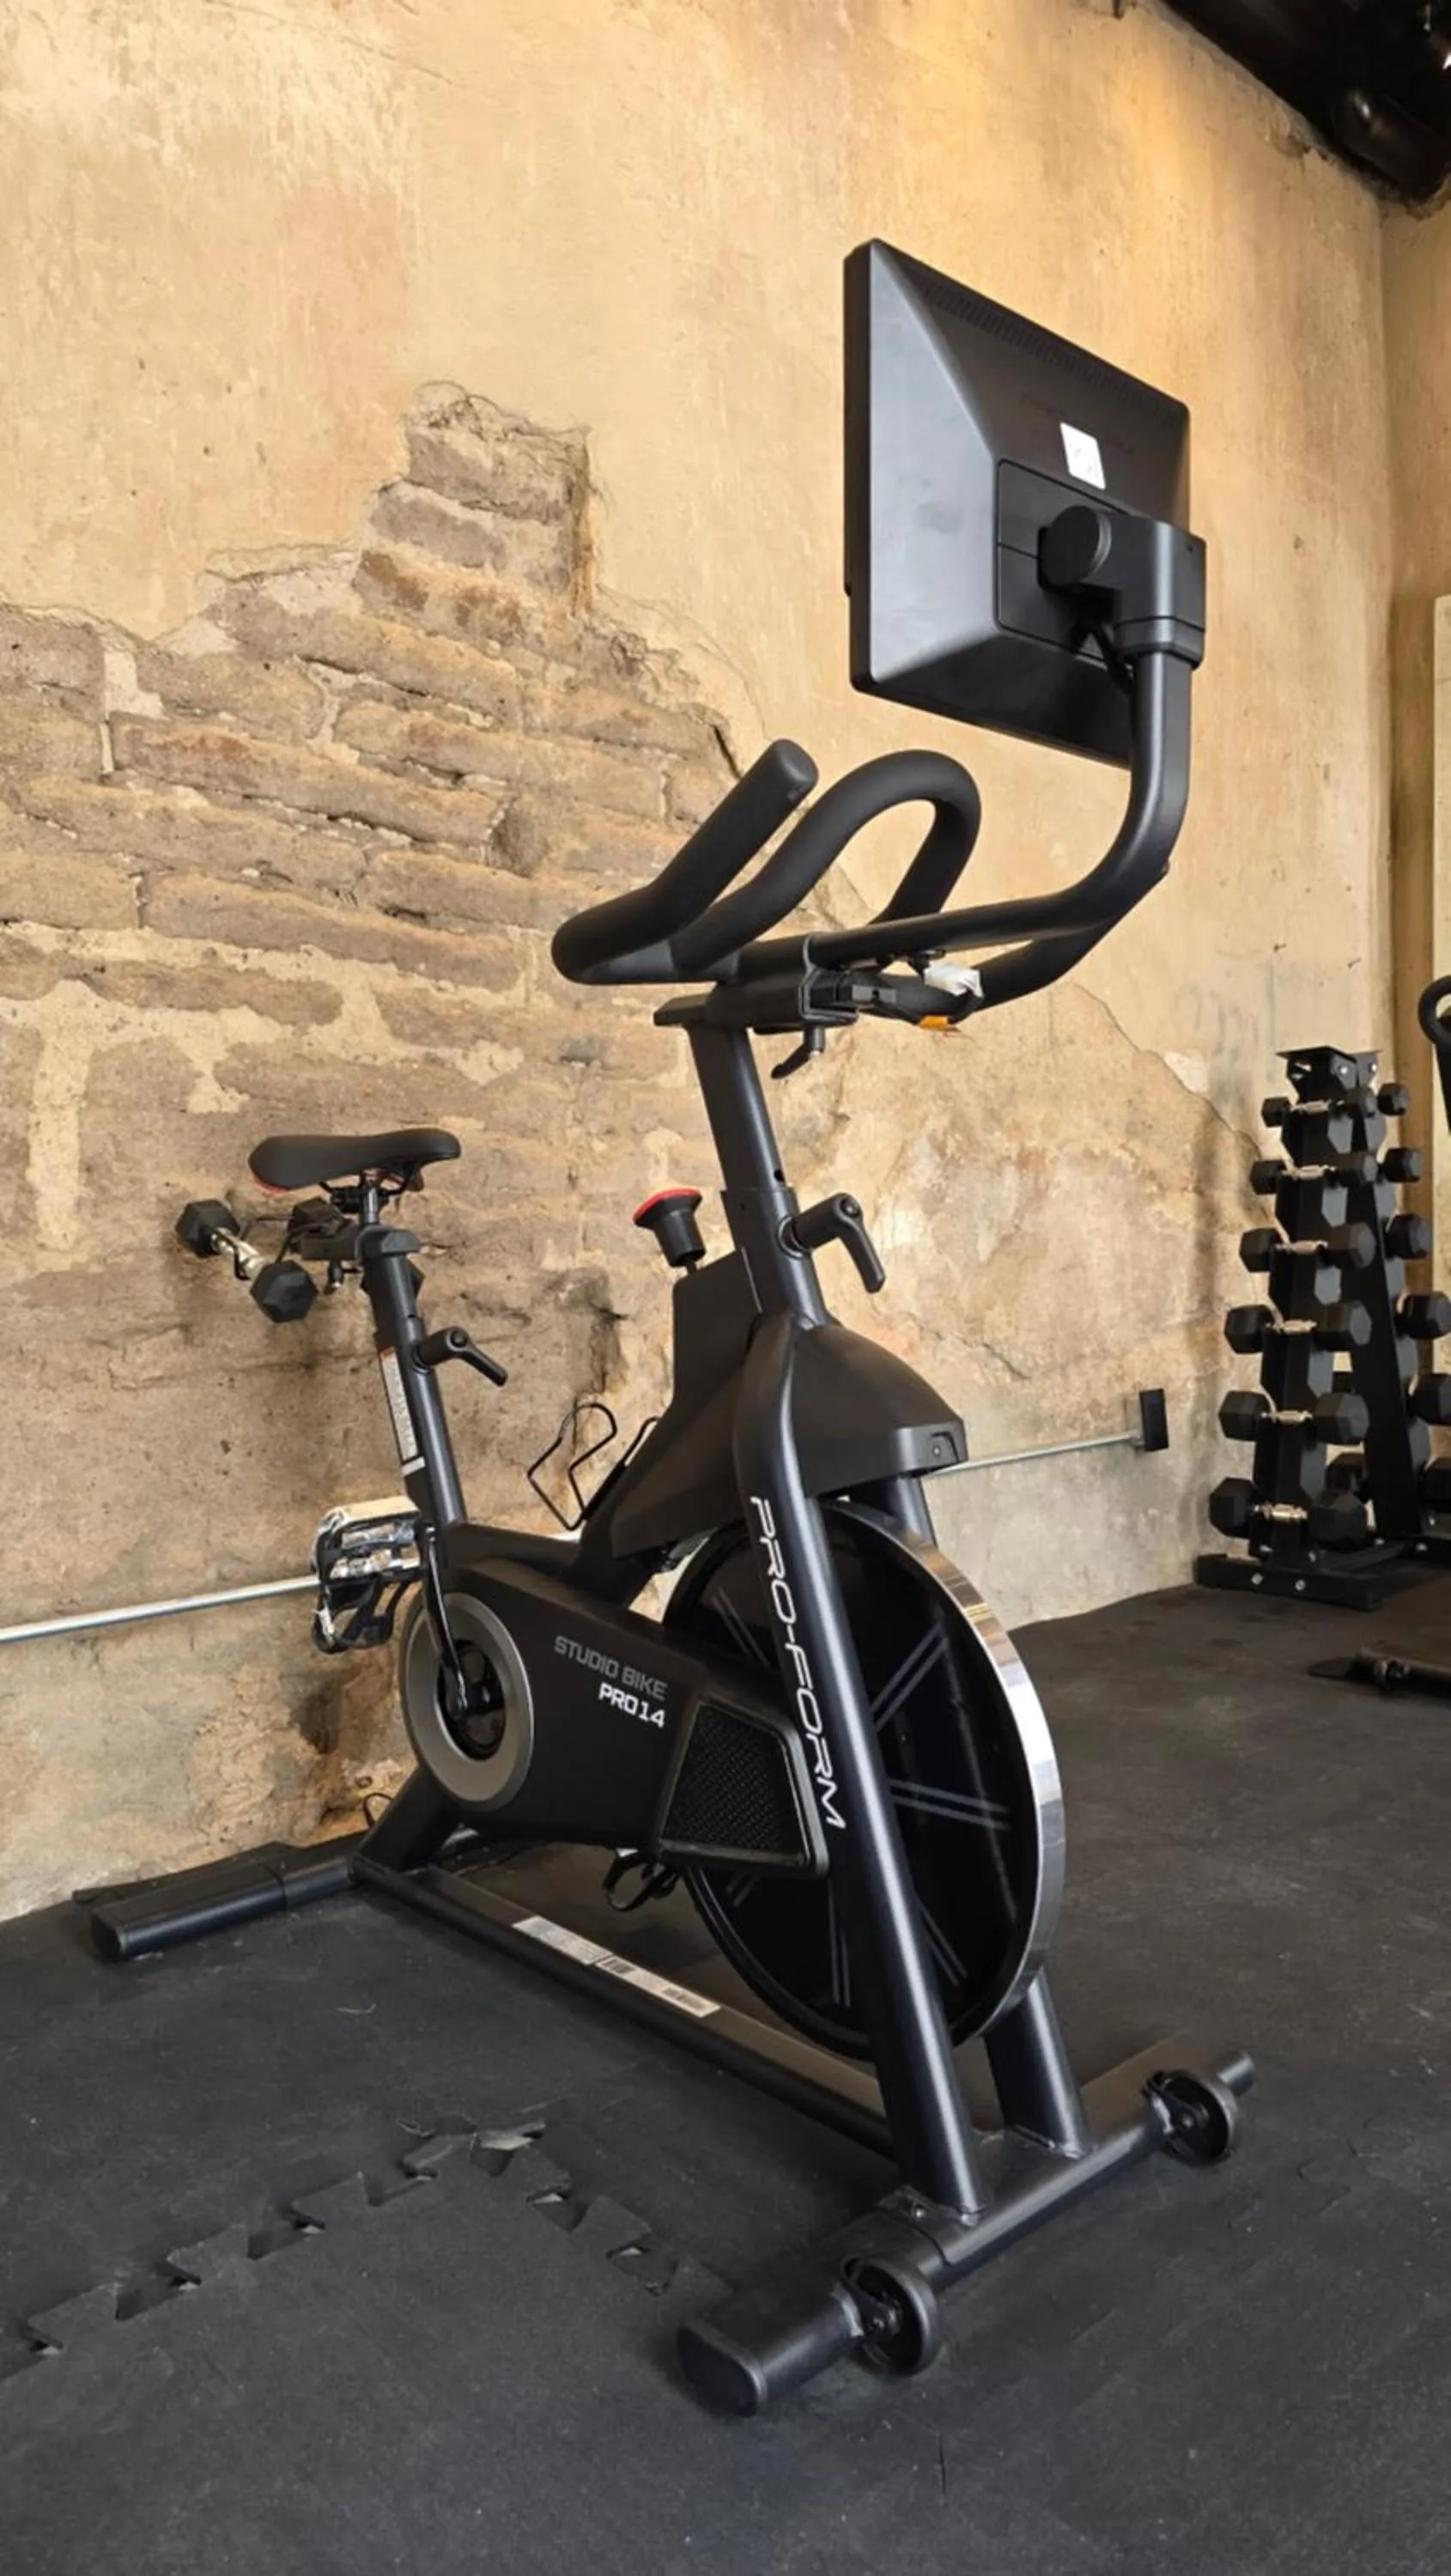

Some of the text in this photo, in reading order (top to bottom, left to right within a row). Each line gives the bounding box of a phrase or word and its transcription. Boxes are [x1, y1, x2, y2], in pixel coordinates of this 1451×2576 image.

[554, 1635, 667, 1701] STUDIO BIKE
[750, 1496, 846, 1829] PRO-FORM
